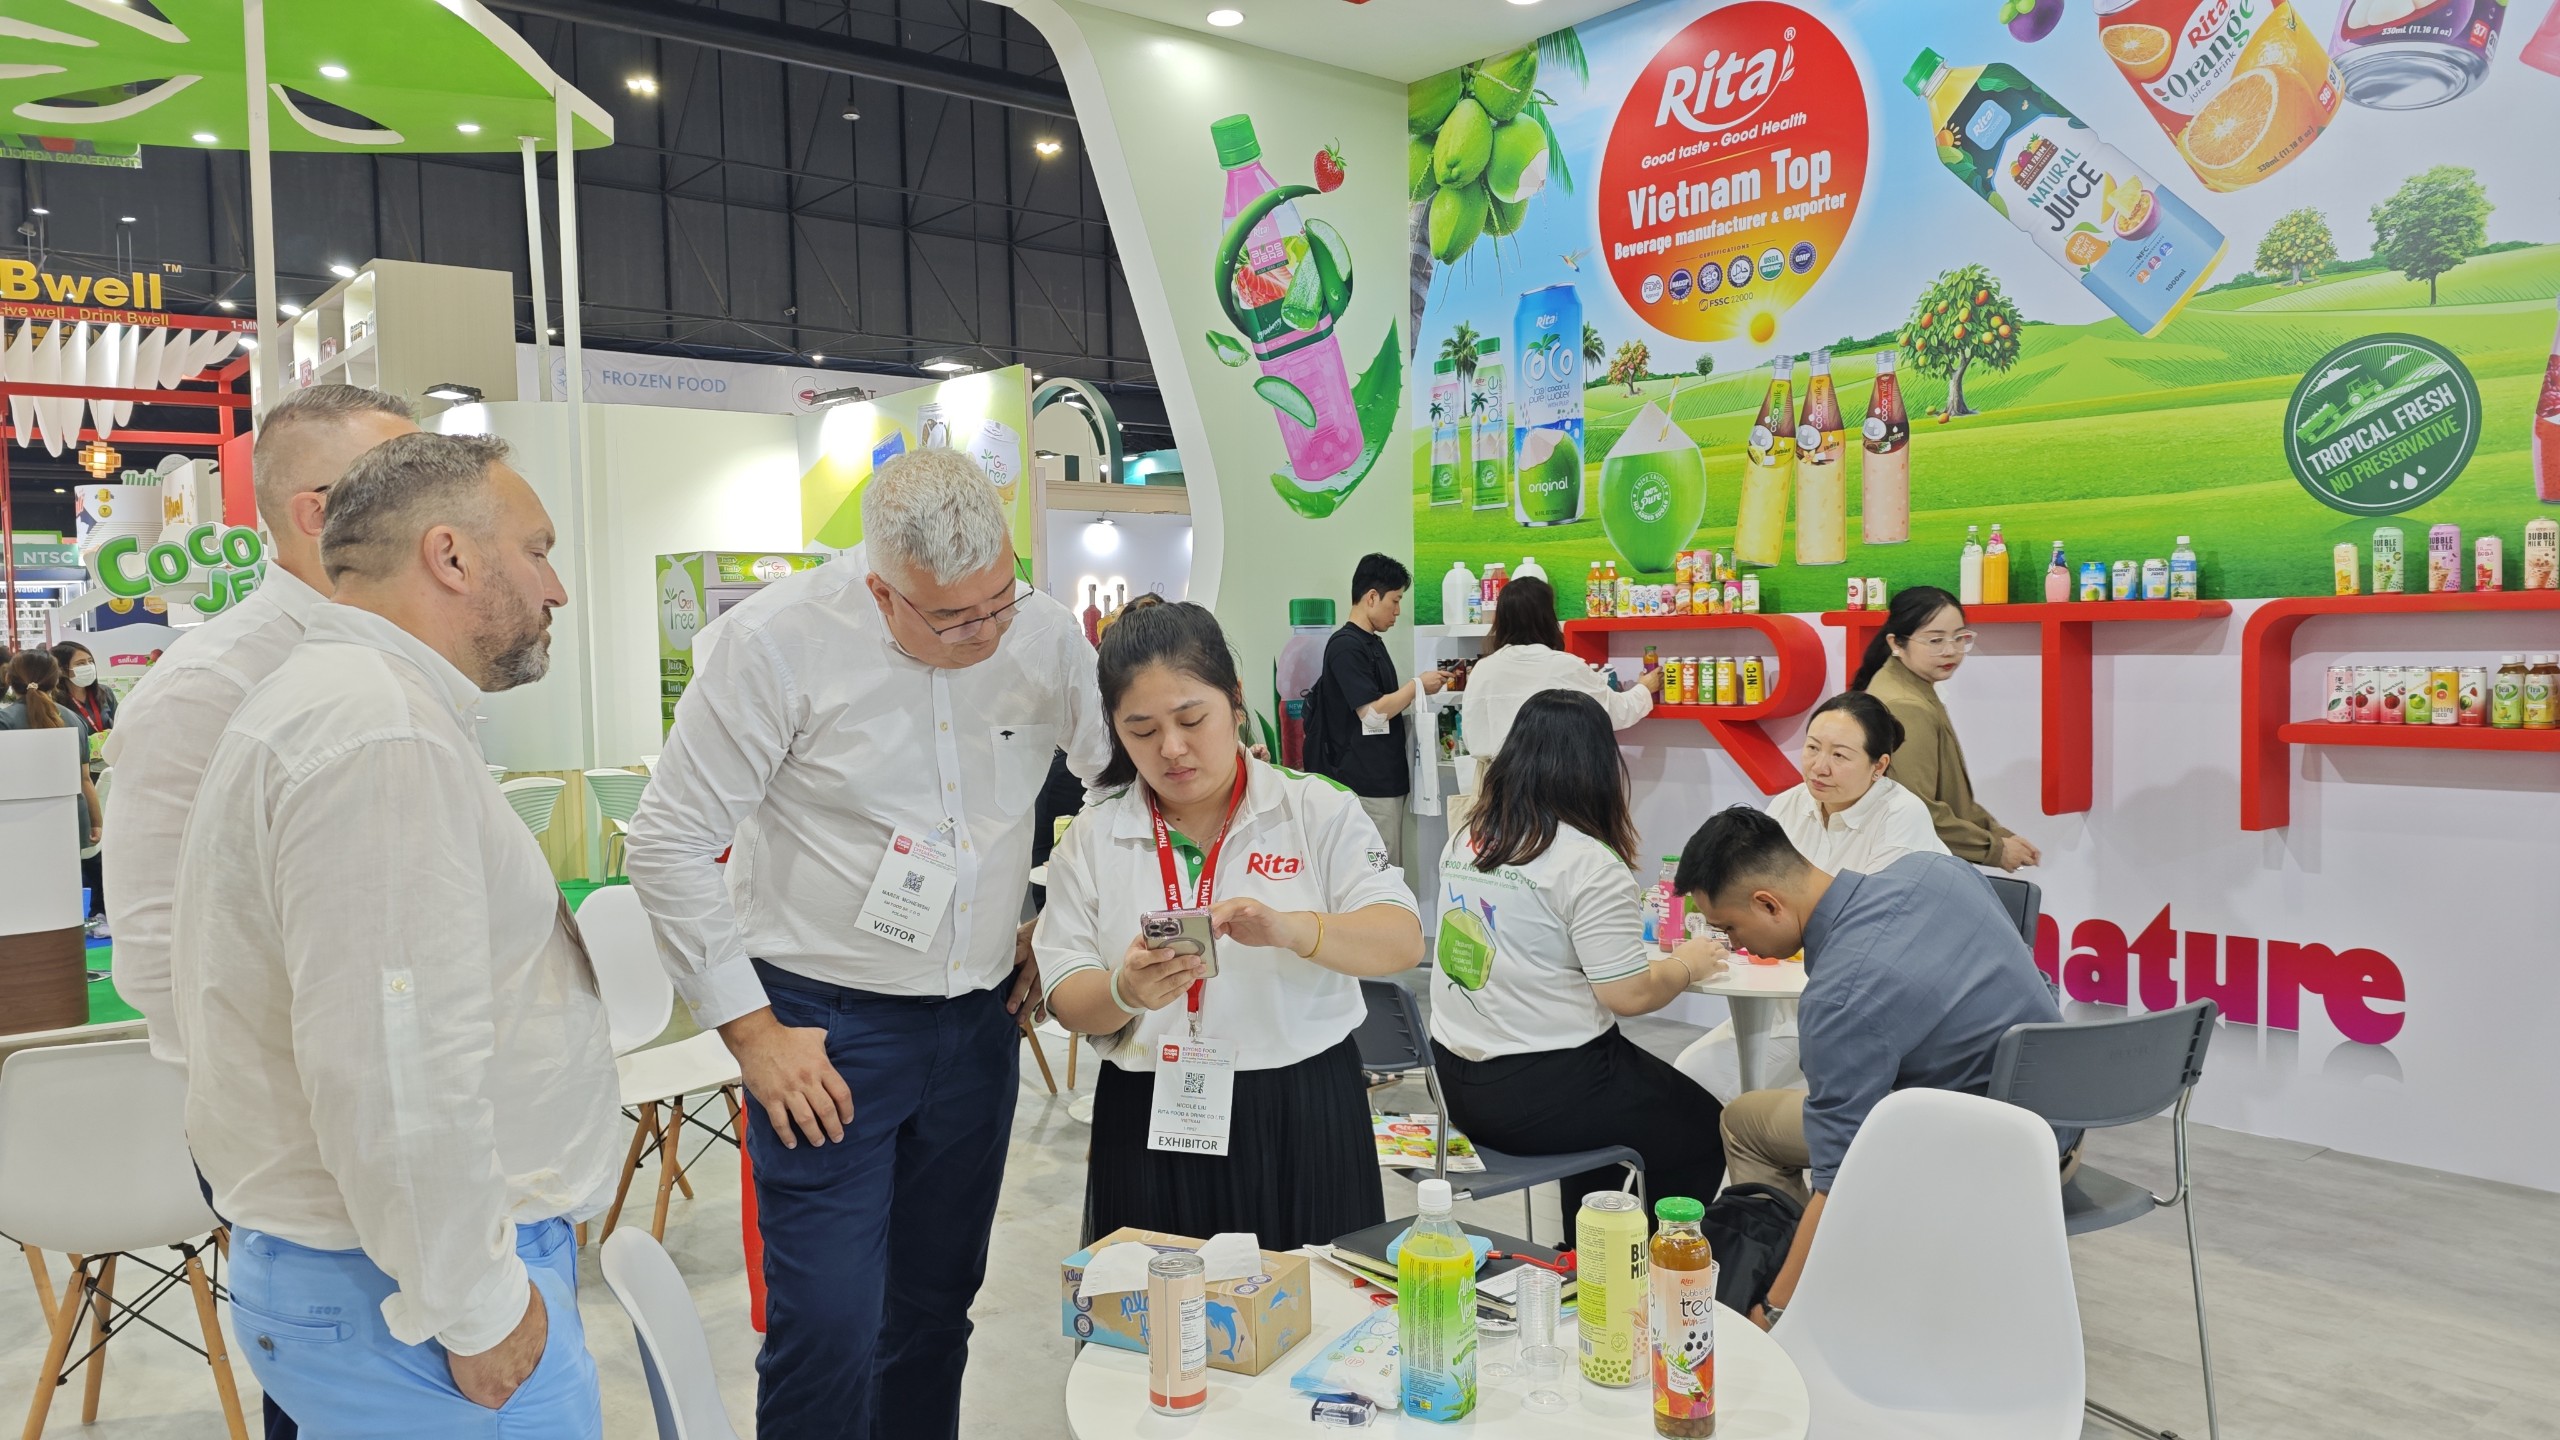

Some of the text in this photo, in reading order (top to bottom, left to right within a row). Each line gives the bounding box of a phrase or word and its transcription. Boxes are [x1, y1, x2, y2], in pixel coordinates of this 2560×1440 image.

[2188, 0, 2229, 49] Rita
[2167, 0, 2255, 98] Orange
[2189, 51, 2236, 103] juice drink
[1655, 49, 1777, 131] Rita
[1641, 151, 1676, 169] Good
[1678, 140, 1710, 158] taste
[1721, 125, 1758, 147] Good
[1761, 112, 1807, 135] Health
[2020, 145, 2048, 179] RITA FARM
[1628, 148, 1831, 230] Vietnam Top
[2027, 148, 2081, 208] NATURAL
[1614, 193, 1846, 260] Beverage manufacturer & exporter
[1699, 243, 1750, 258] CERTIFICATIONS
[1764, 255, 1779, 264] USDA
[1795, 253, 1811, 263] GMP
[2136, 246, 2150, 260] NFC
[0, 259, 162, 309] Bwell
[1709, 292, 1754, 307] FSSC 22000
[35, 306, 65, 319] well
[80, 309, 121, 321] Drink
[128, 313, 169, 325] Bwell
[1536, 314, 1557, 329] Rita
[602, 370, 727, 393] FROZEN FOOD
[2306, 382, 2457, 475] TROPICAL FRESH
[2328, 414, 2461, 495] NO PRESERVATIVE
[1529, 476, 1568, 496] original
[2527, 532, 2556, 541] BUBBLE
[23, 551, 73, 564] NTSC
[1667, 667, 1676, 685] NFC
[1746, 667, 1757, 685] NFC
[1156, 817, 1168, 848] THAIFEX
[1246, 852, 1300, 880] Rita
[1168, 884, 1177, 900] Asia
[874, 920, 915, 943] VISITOR
[1159, 1136, 1217, 1150] EXHIBITOR
